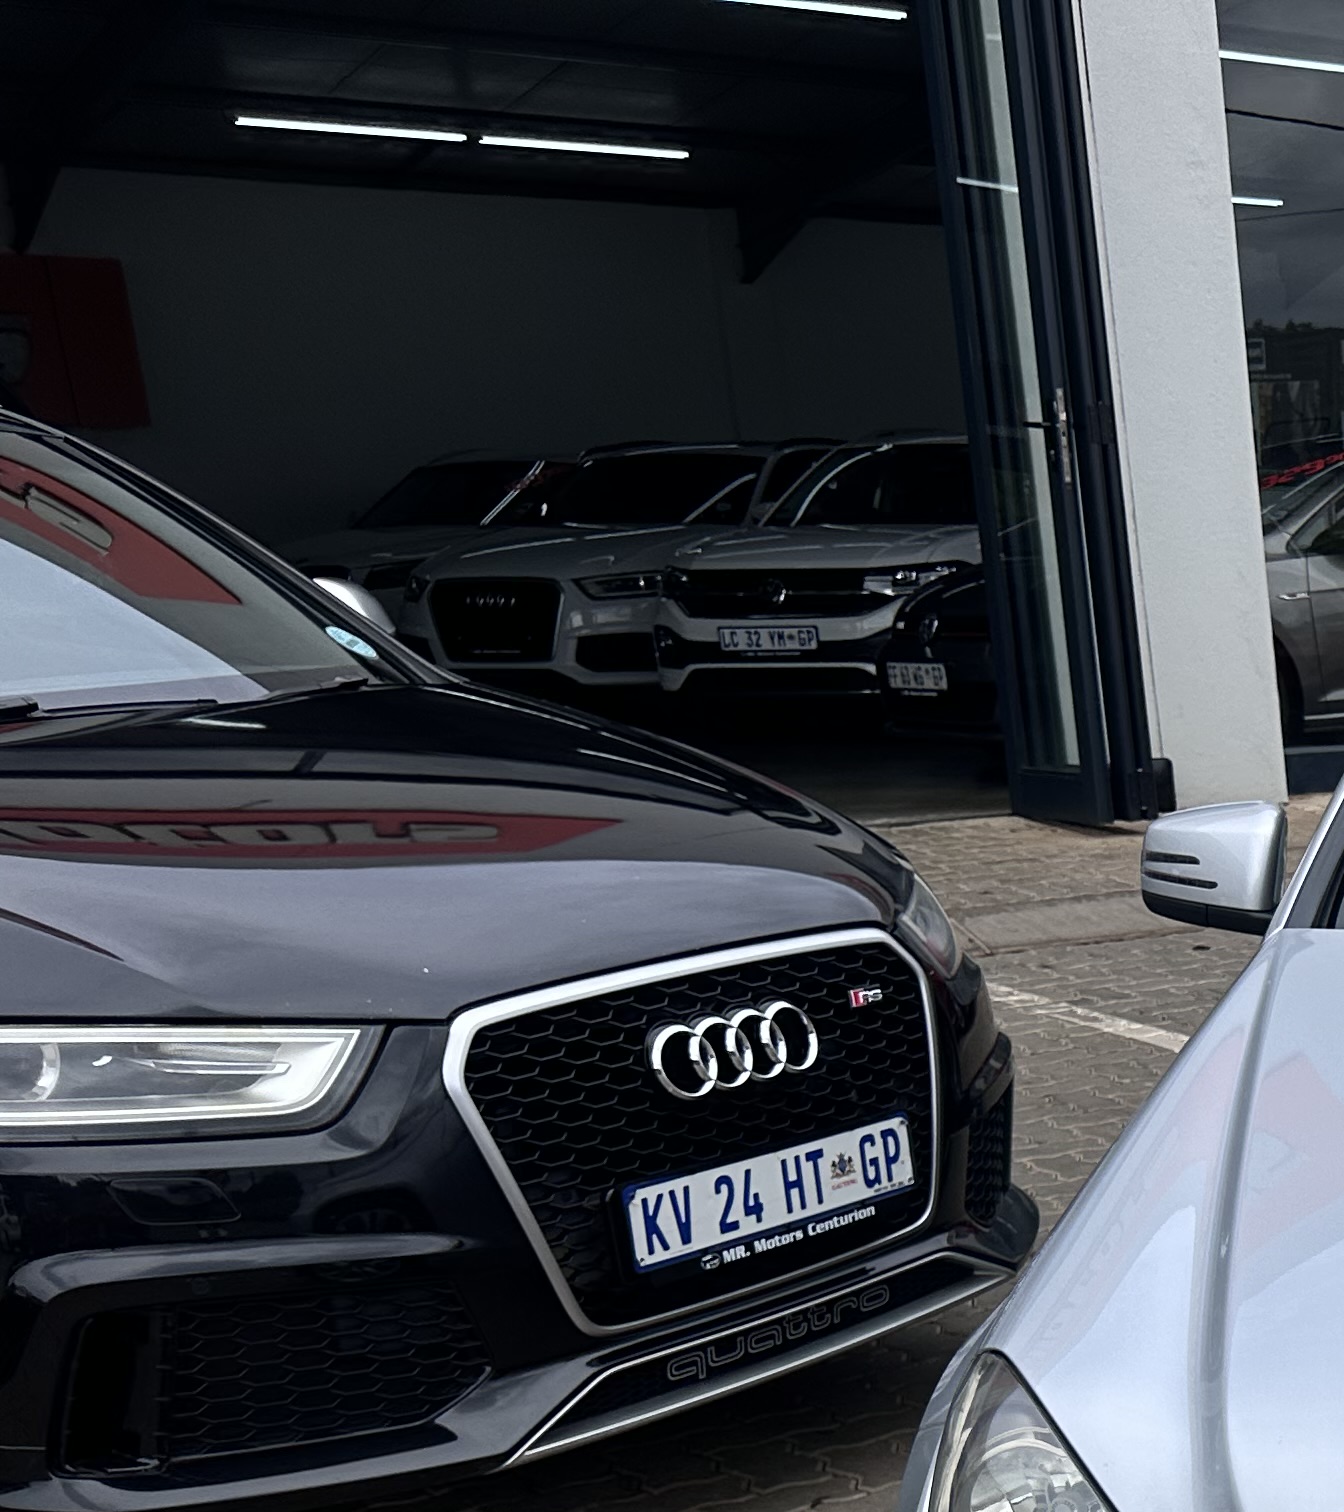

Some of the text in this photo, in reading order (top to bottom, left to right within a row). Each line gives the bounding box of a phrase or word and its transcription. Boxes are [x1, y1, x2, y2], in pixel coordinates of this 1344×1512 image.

[721, 632, 739, 648] LC
[745, 631, 762, 648] 32
[797, 630, 814, 647] GP
[641, 1128, 901, 1256] KV 24 HT GP
[722, 1205, 876, 1264] MR. Motors Centurion
[666, 1284, 890, 1381] quattro
